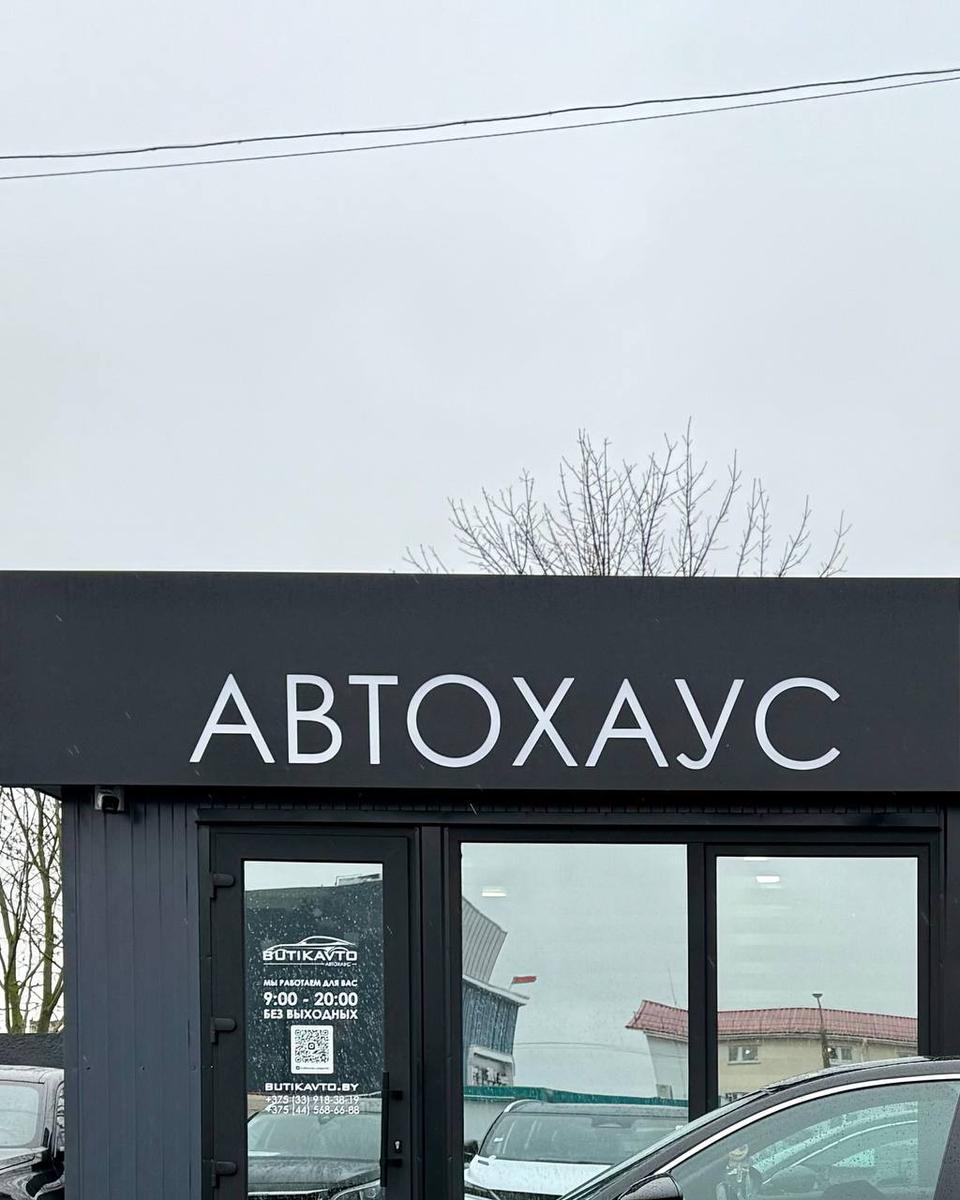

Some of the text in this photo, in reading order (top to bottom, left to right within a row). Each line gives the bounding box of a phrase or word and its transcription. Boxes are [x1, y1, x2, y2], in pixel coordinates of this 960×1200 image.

[189, 673, 841, 770] АВТОХАУС
[263, 950, 358, 961] BUTIKAVTO
[263, 979, 358, 988] МЫ РАБОТАЕМ ДЛЯ ВАС
[263, 991, 298, 1006] 9:00
[314, 991, 358, 1006] 20:00
[263, 1008, 358, 1020] БЕЗ ВЫХОДНЫХ
[264, 1082, 360, 1092] BUTIKAVTO.BY
[265, 1095, 360, 1106] +375 (33) 918-38-19
[291, 1105, 311, 1116] (44)
[312, 1105, 360, 1115] 568-66-88
